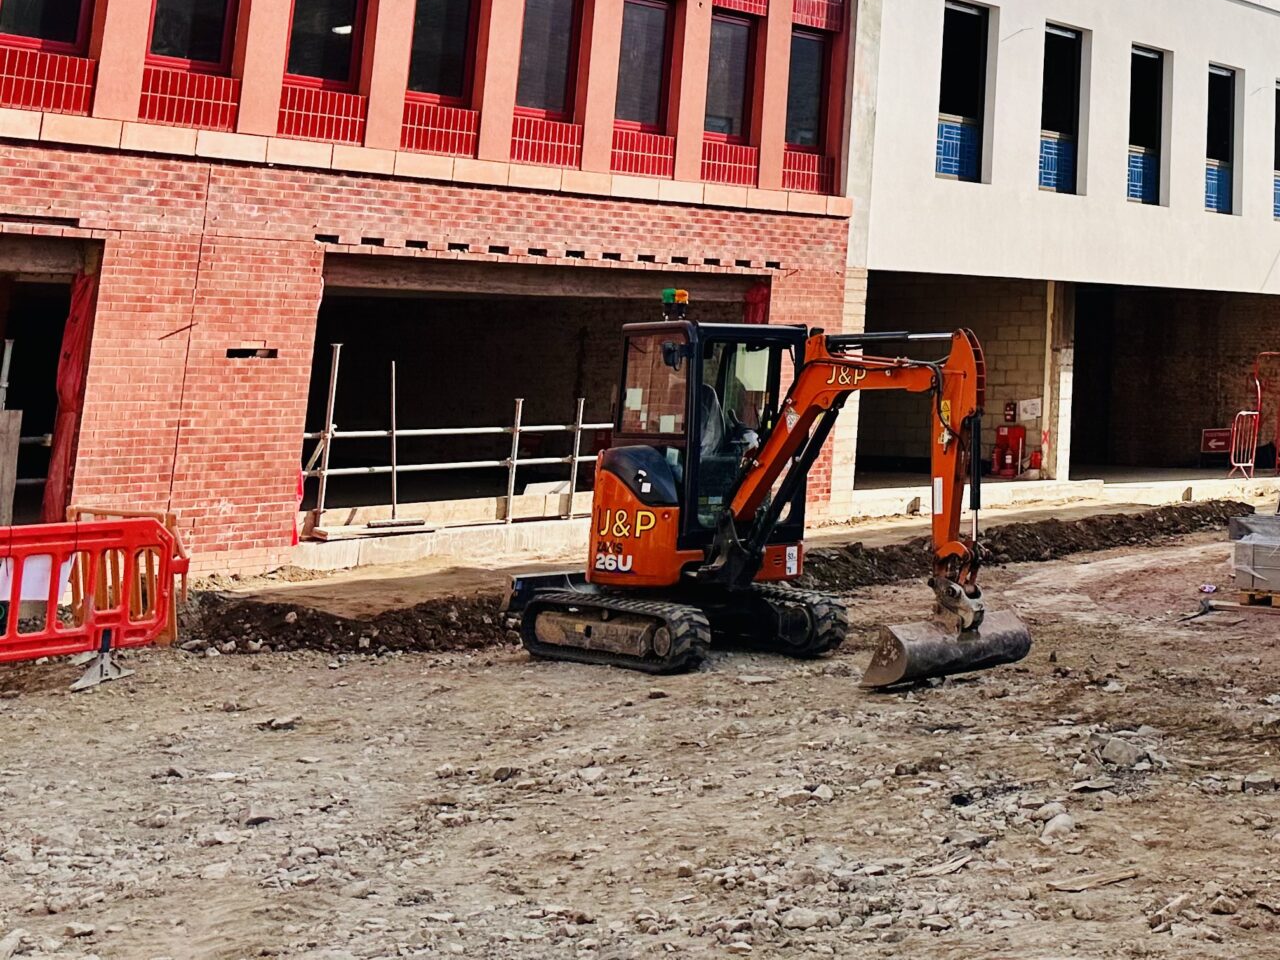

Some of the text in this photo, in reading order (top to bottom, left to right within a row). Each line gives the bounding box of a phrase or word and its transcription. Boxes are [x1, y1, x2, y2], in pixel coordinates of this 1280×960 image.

[826, 365, 867, 385] J&P
[600, 509, 656, 538] J&P
[595, 553, 633, 572] 26U
